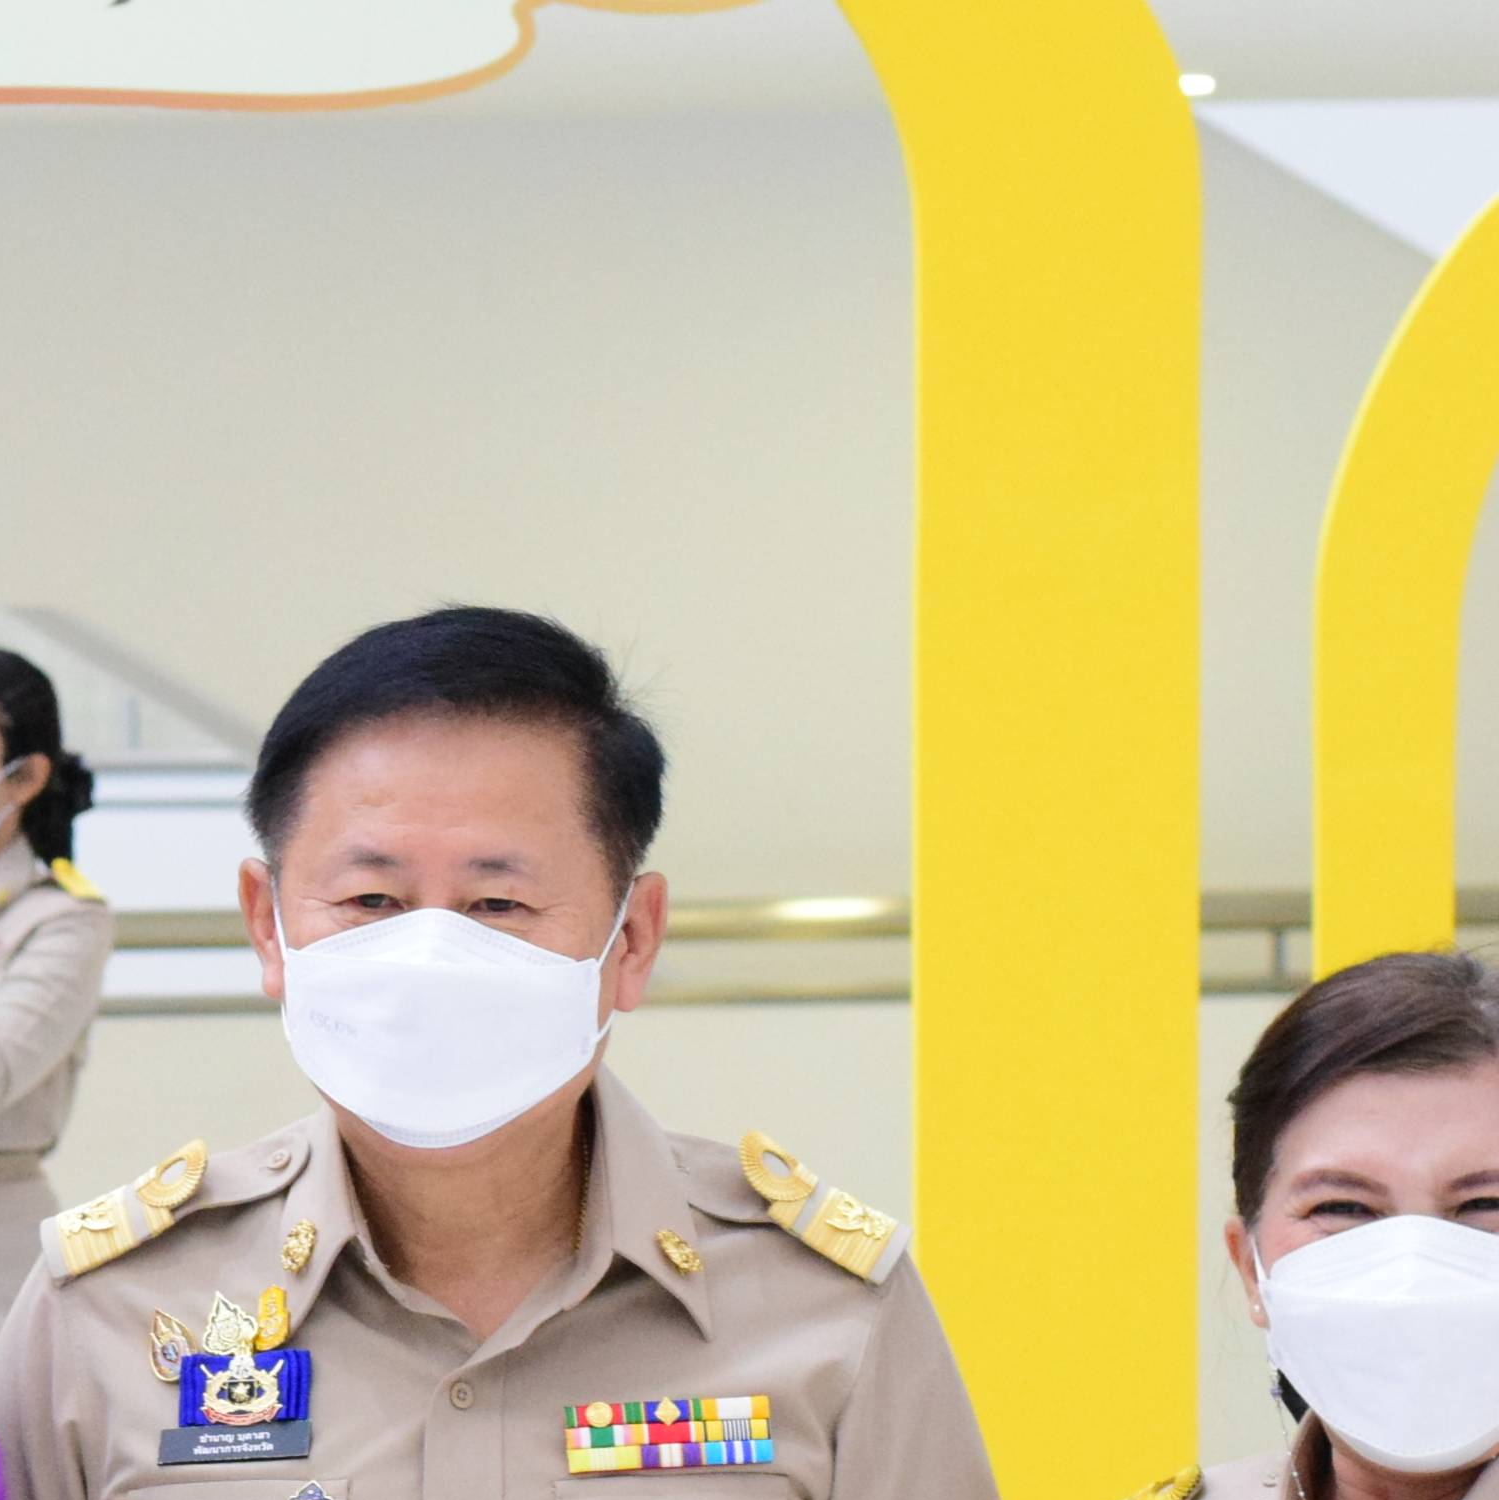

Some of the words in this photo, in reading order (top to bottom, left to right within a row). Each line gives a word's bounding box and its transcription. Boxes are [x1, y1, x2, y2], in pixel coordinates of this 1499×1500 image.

[198, 1432, 235, 1443] ชำนาญ
[192, 1440, 274, 1455] พัฒนาการจังหวัด
